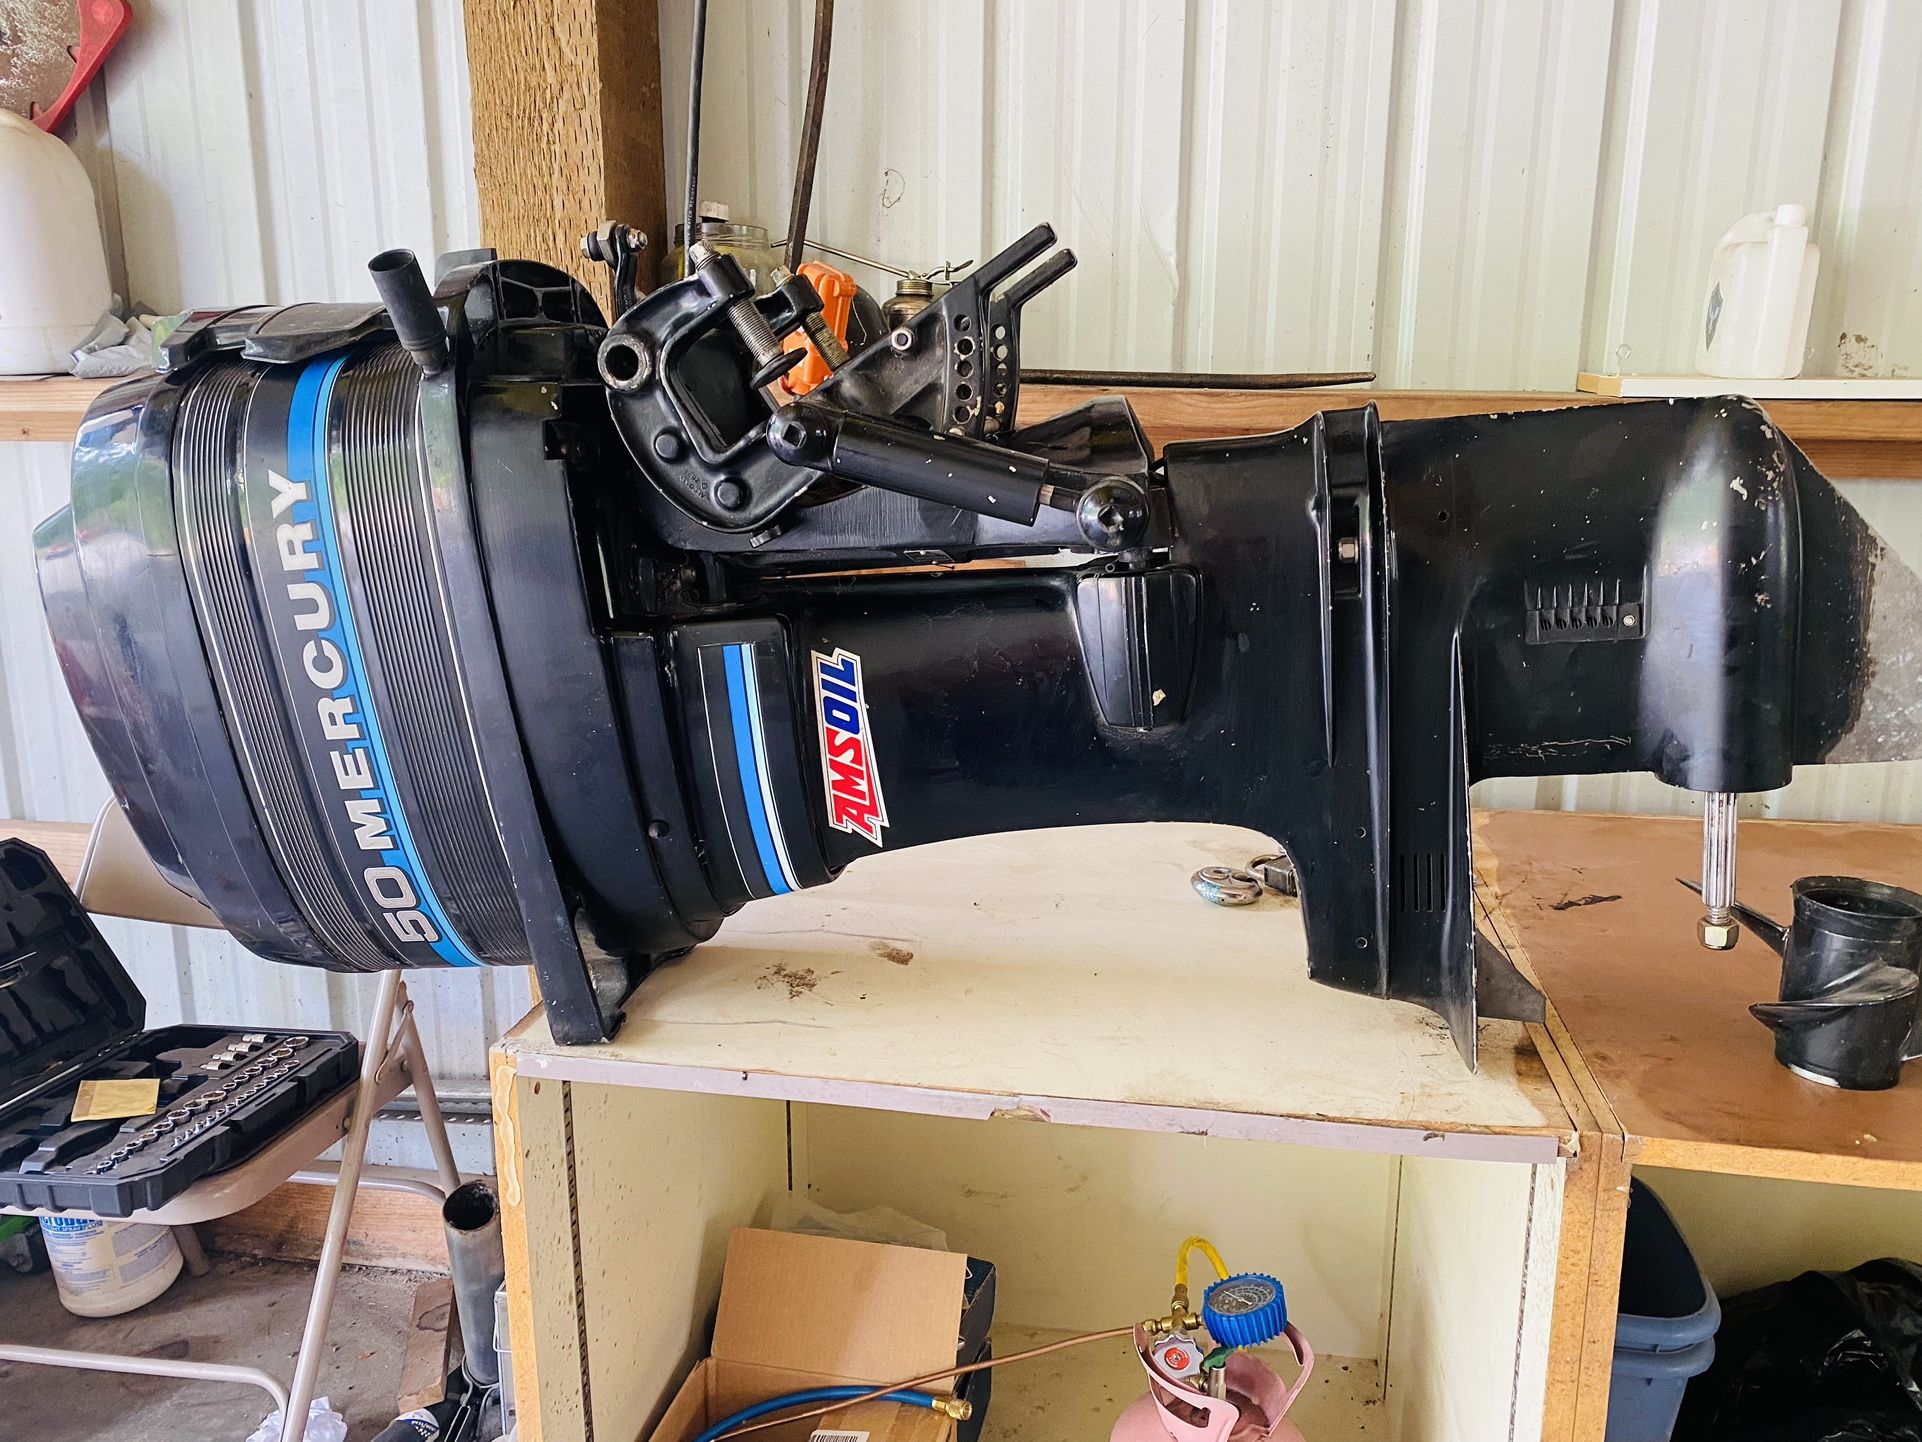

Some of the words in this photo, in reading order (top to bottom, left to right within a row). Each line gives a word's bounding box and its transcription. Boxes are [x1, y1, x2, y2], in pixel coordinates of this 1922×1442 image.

[267, 469, 397, 851] MERCURY
[818, 655, 880, 837] AMSOIL
[363, 866, 440, 944] 50
